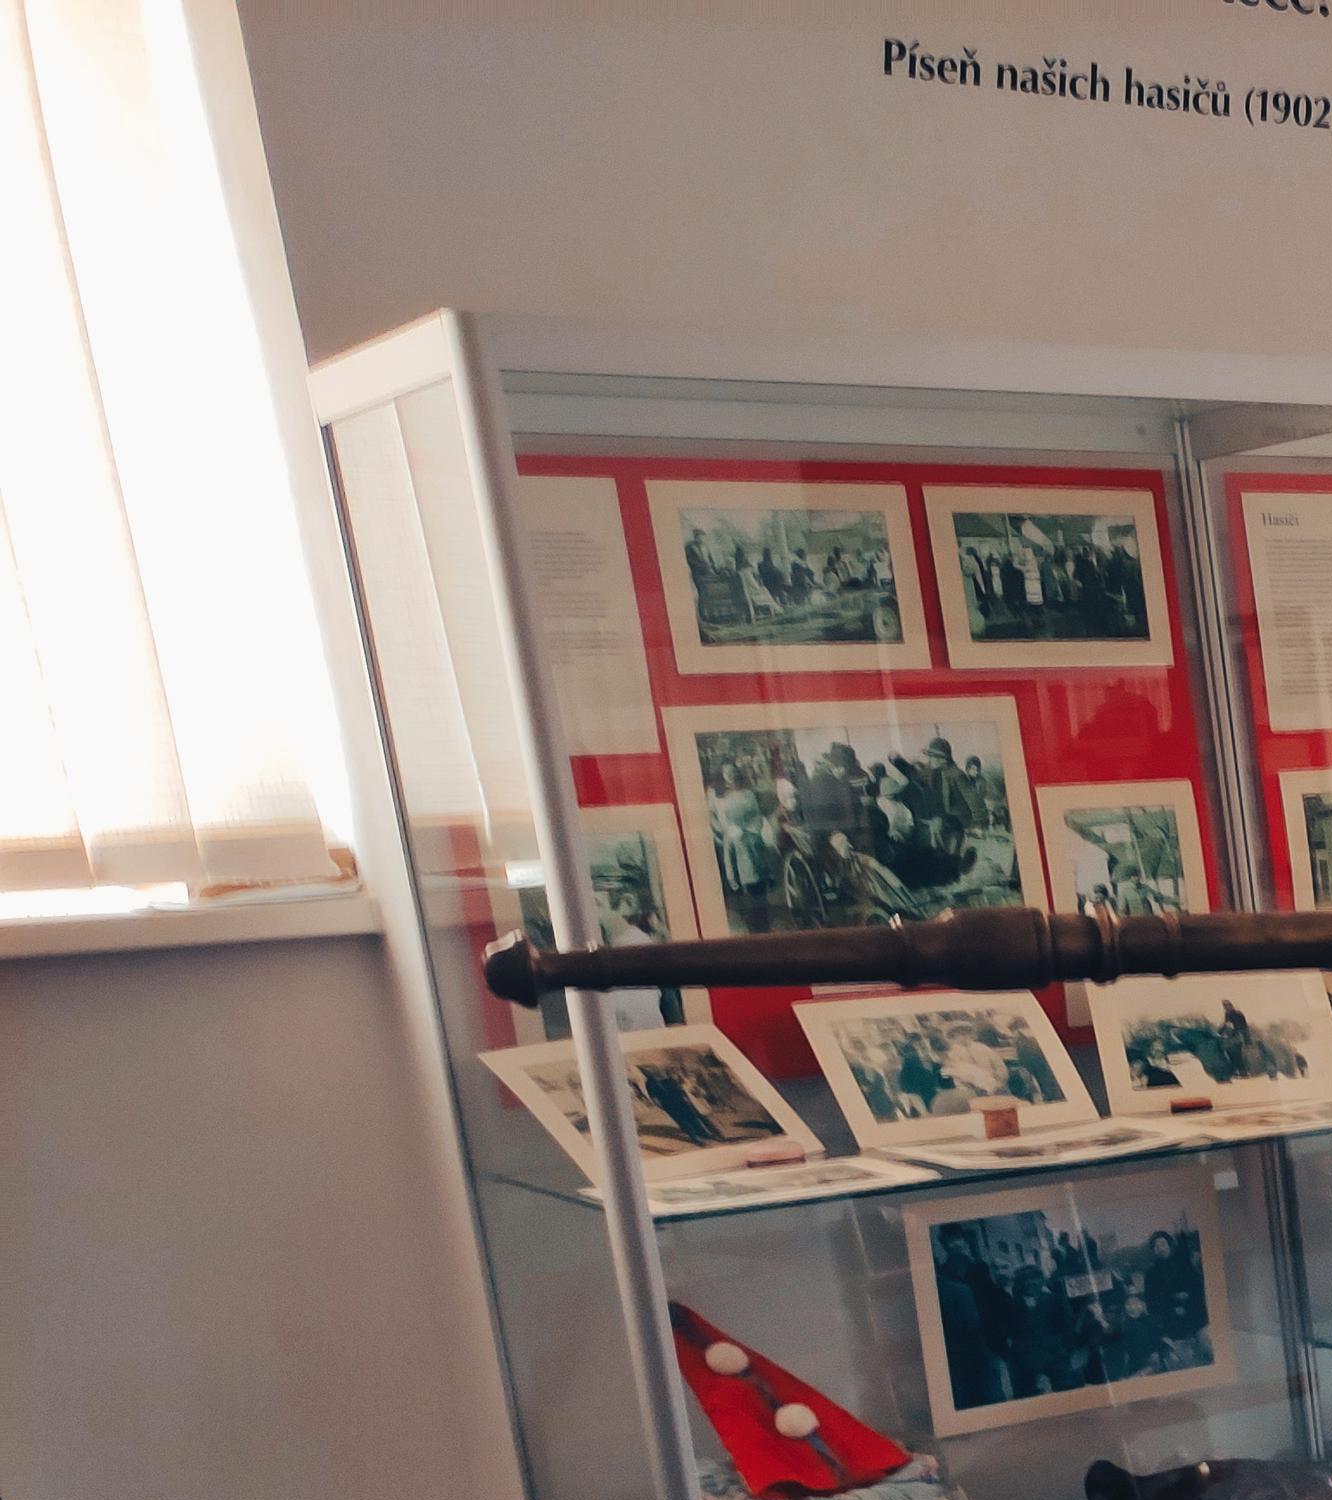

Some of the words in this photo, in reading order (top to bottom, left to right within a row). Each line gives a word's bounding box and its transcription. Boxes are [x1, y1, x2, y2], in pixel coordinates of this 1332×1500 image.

[882, 37, 981, 87] Píseň
[996, 57, 1110, 102] našich
[1124, 68, 1231, 118] hasičů
